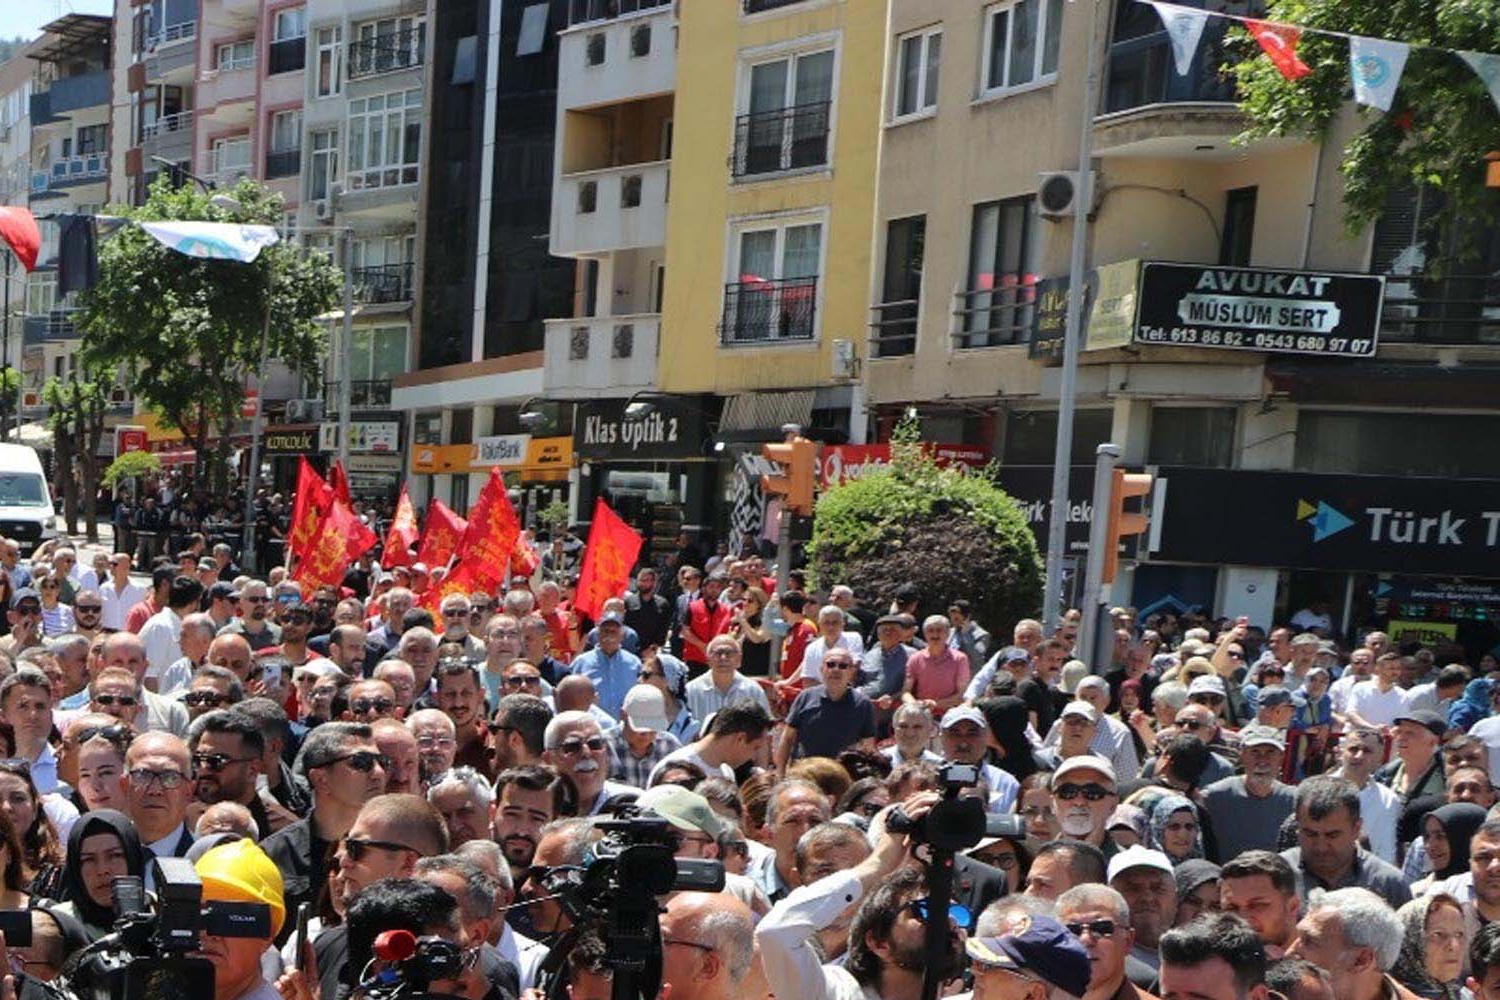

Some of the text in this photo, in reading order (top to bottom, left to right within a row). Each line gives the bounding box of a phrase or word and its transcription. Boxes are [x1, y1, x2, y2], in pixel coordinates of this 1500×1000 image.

[1196, 270, 1332, 297] AVUKAT
[1189, 299, 1329, 329] MÜSLÜM SERT
[1141, 325, 1168, 342] Tel:
[1171, 327, 1198, 343] 613
[1202, 329, 1221, 345] 86
[1224, 330, 1243, 346] 82
[1255, 332, 1295, 349] 0543
[1297, 335, 1326, 350] 680
[1329, 337, 1347, 352] 97
[1351, 339, 1371, 354] 07
[584, 415, 618, 444] Klas
[668, 417, 679, 442] 2
[1365, 507, 1467, 546] Türk
